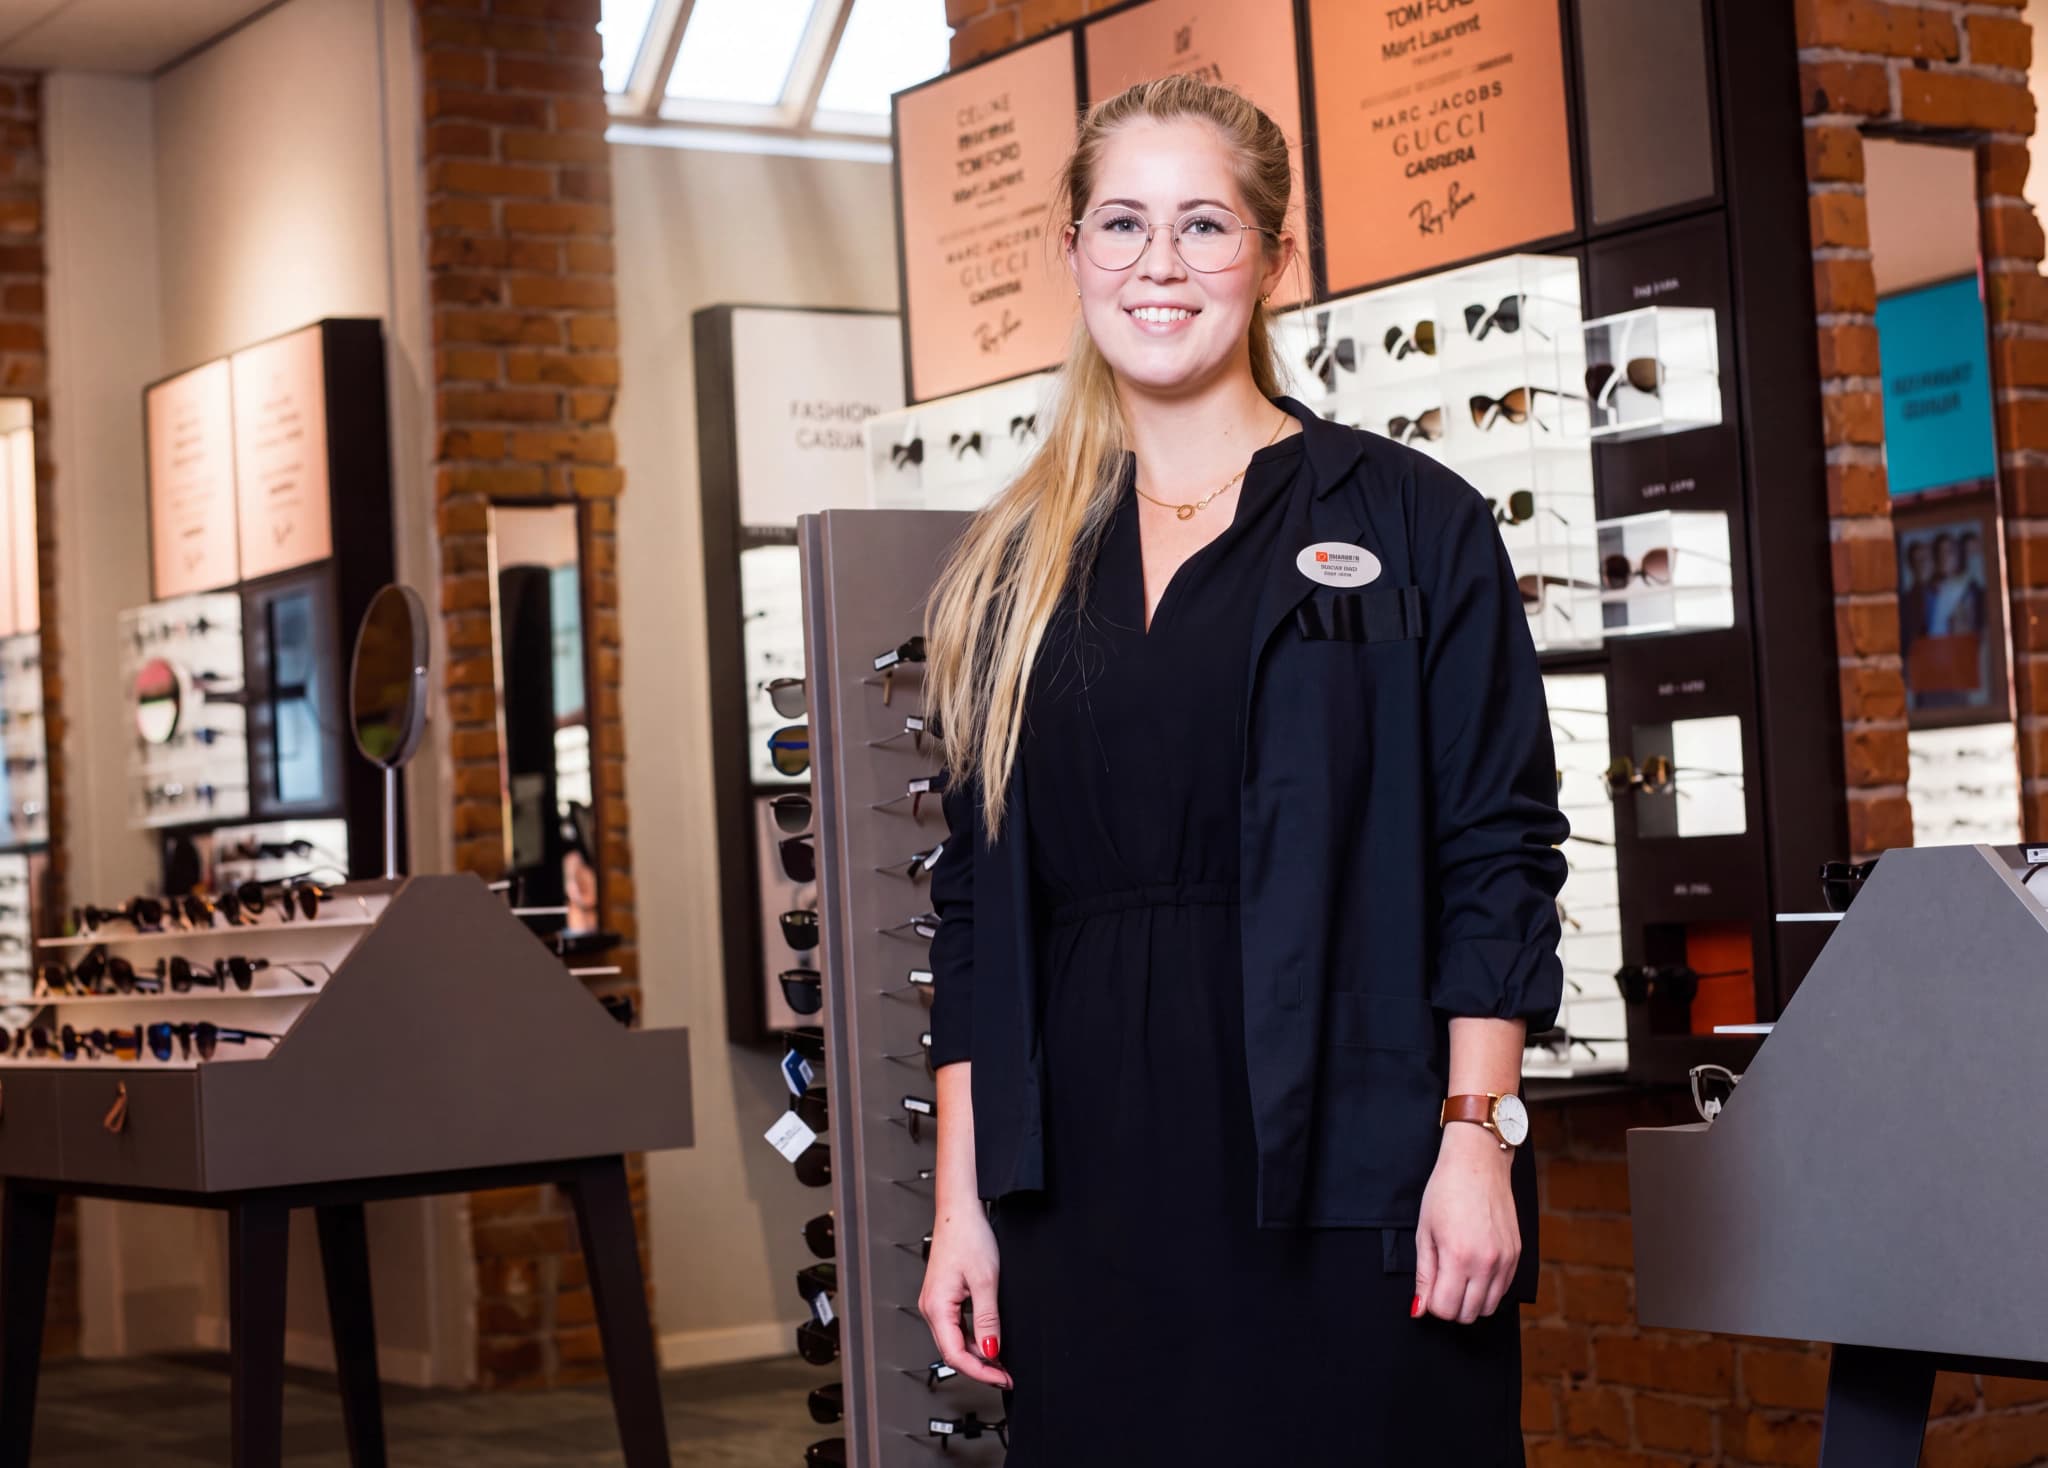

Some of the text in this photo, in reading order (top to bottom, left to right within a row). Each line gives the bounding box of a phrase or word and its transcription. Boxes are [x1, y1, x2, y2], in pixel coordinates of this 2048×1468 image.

[1427, 0, 1475, 16] FO
[1372, 106, 1420, 132] MARC
[1429, 80, 1502, 116] JACOBS
[1393, 110, 1484, 157] GUCCI
[1405, 146, 1475, 178] CARRERA
[796, 428, 864, 449] CASUA
